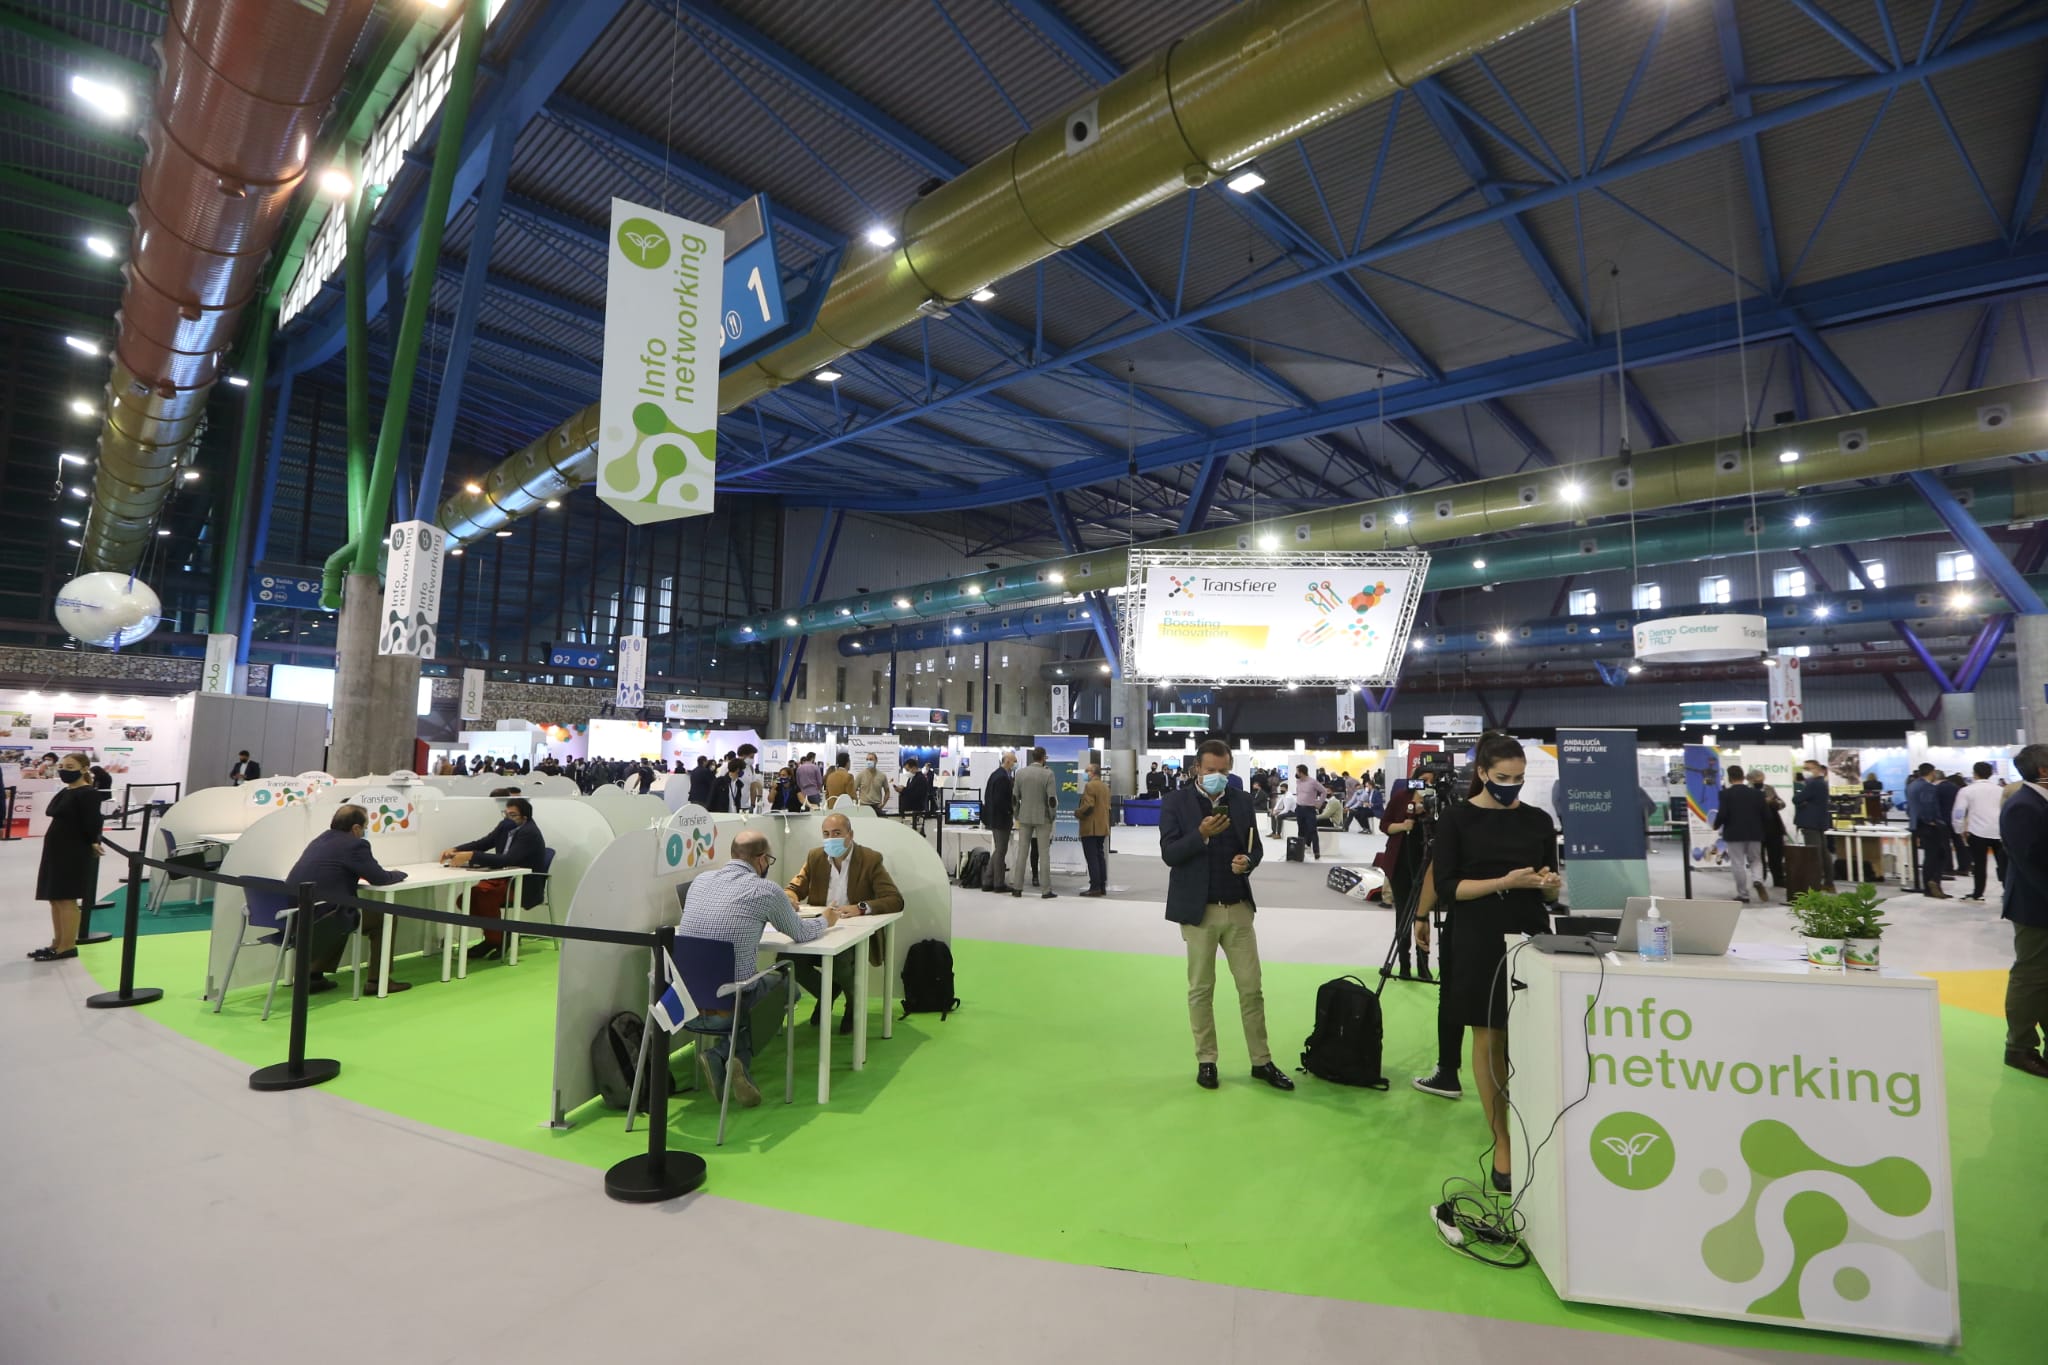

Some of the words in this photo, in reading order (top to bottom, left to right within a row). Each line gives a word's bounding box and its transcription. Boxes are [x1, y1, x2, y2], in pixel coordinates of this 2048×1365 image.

[747, 266, 771, 322] 1
[672, 232, 707, 404] networking
[638, 337, 667, 397] Info
[400, 527, 414, 607] networking
[427, 534, 442, 612] networking
[1202, 578, 1277, 592] Transfiere
[391, 580, 401, 607] Info
[419, 582, 428, 609] Info
[1163, 617, 1221, 629] Boosting
[1162, 628, 1229, 638] Innovation
[1648, 627, 1677, 637] Demo
[1679, 625, 1720, 634] Center
[1649, 636, 1672, 645] TRL7
[1563, 737, 1600, 746] ANDALUCÍA
[361, 794, 398, 805] Transfiere
[1567, 789, 1603, 799] Súmate
[1604, 789, 1612, 799] al
[679, 814, 708, 827] Transfiere
[672, 843, 677, 857] 1
[1587, 994, 1693, 1041] Info
[1588, 1048, 1922, 1117] networking
